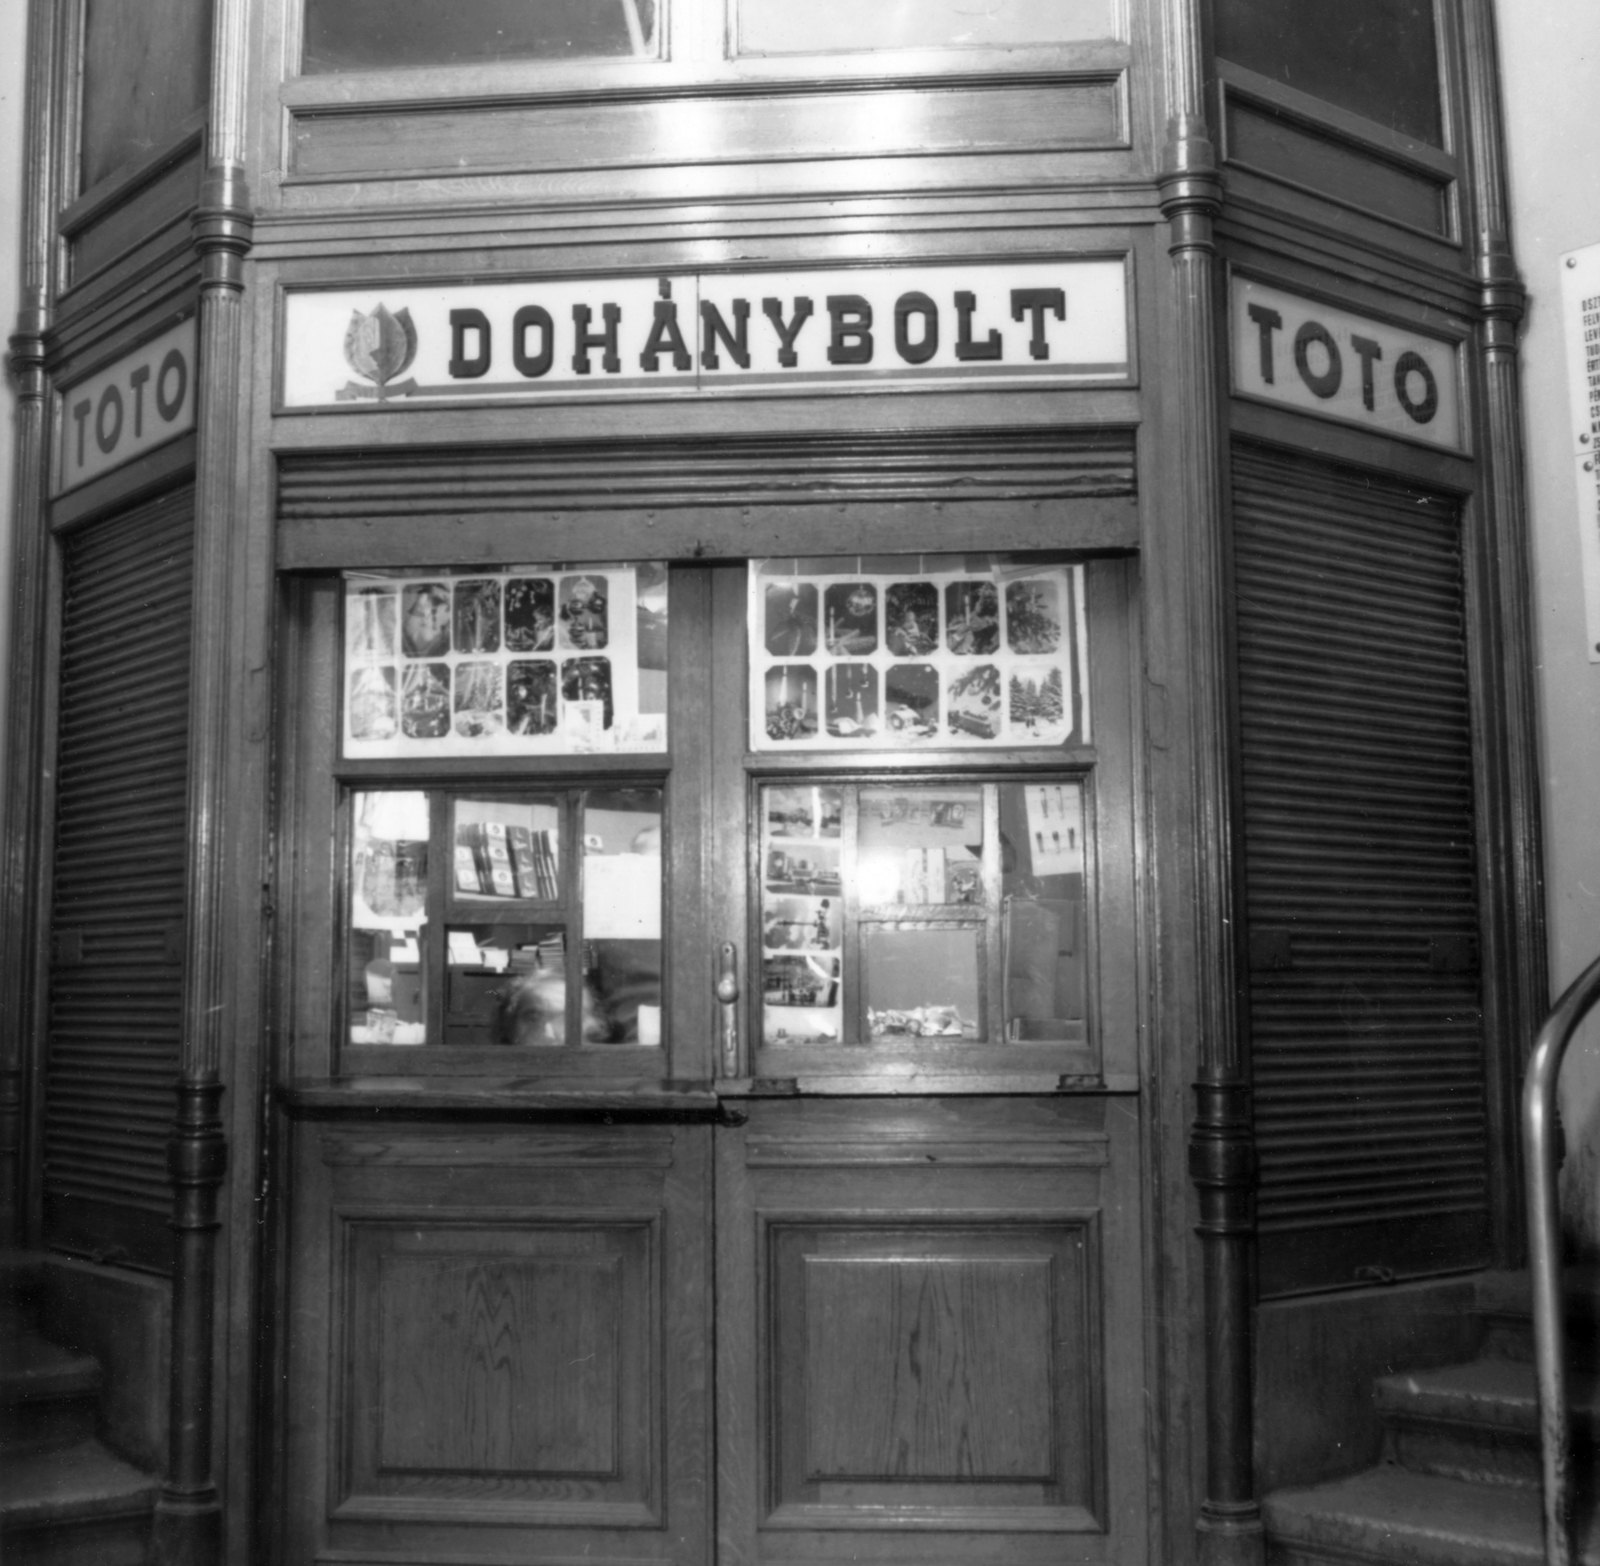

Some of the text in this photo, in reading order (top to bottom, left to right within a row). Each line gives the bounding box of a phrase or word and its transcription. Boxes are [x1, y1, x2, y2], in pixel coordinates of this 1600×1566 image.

[448, 277, 1066, 379] DOHÁNYBOLT
[1247, 302, 1438, 424] TOTO
[73, 348, 188, 467] TOTO
